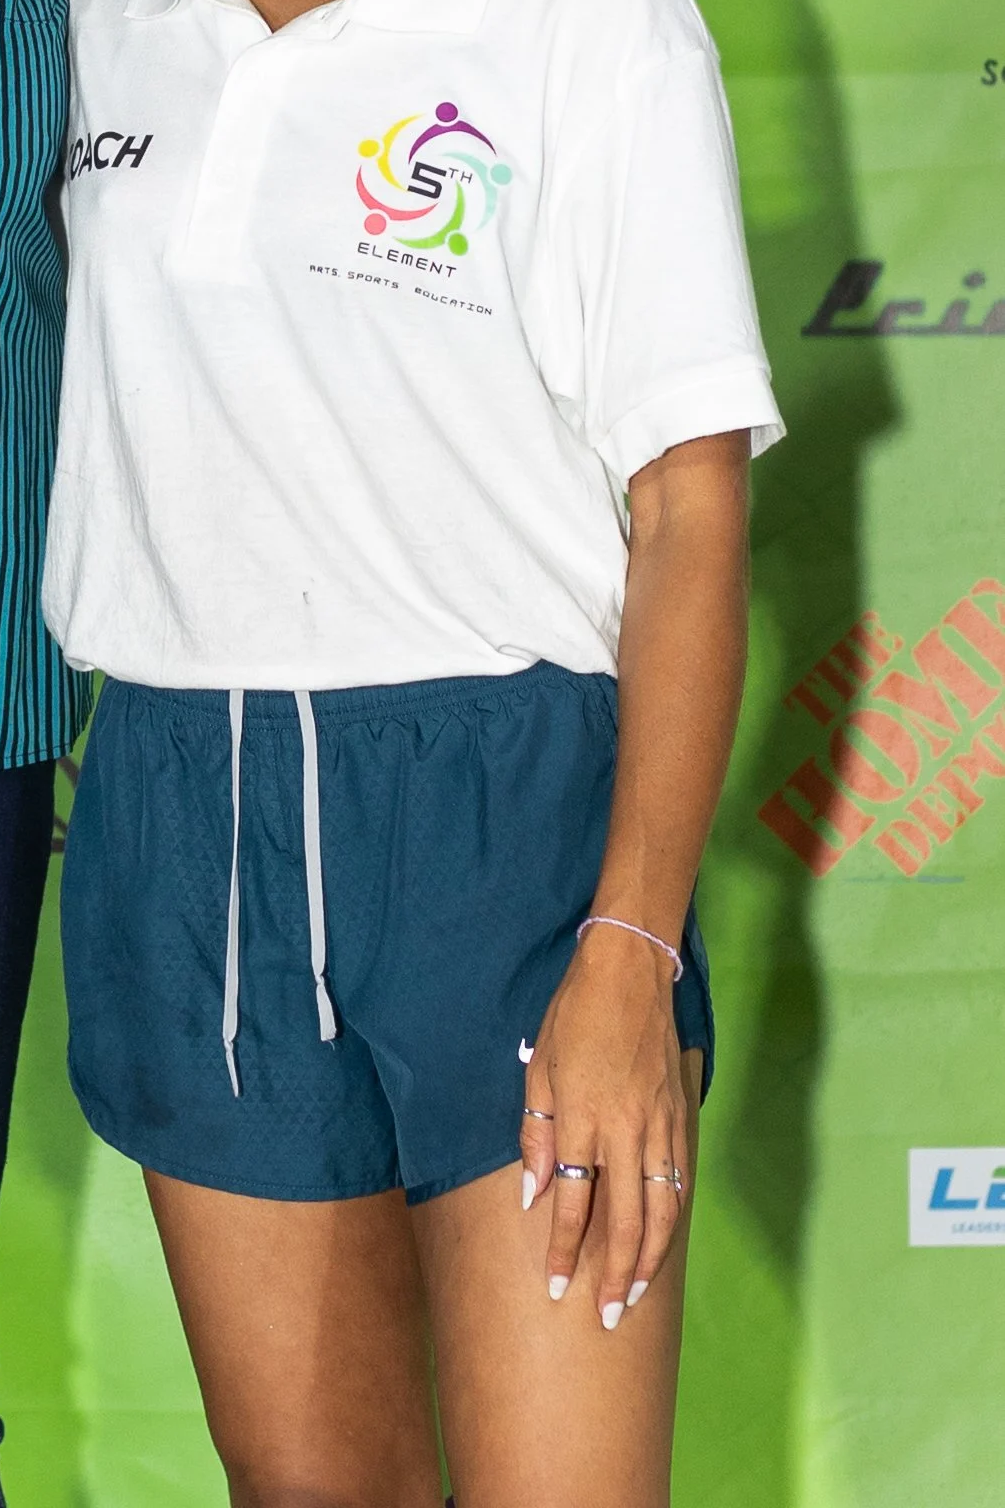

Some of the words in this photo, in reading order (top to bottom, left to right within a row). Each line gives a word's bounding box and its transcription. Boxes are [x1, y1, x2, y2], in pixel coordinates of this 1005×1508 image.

[70, 131, 154, 181] OACH
[407, 161, 474, 199] 5TH
[357, 241, 457, 278] ELEMENT
[347, 271, 399, 289] SPORTS
[783, 610, 905, 729] THE
